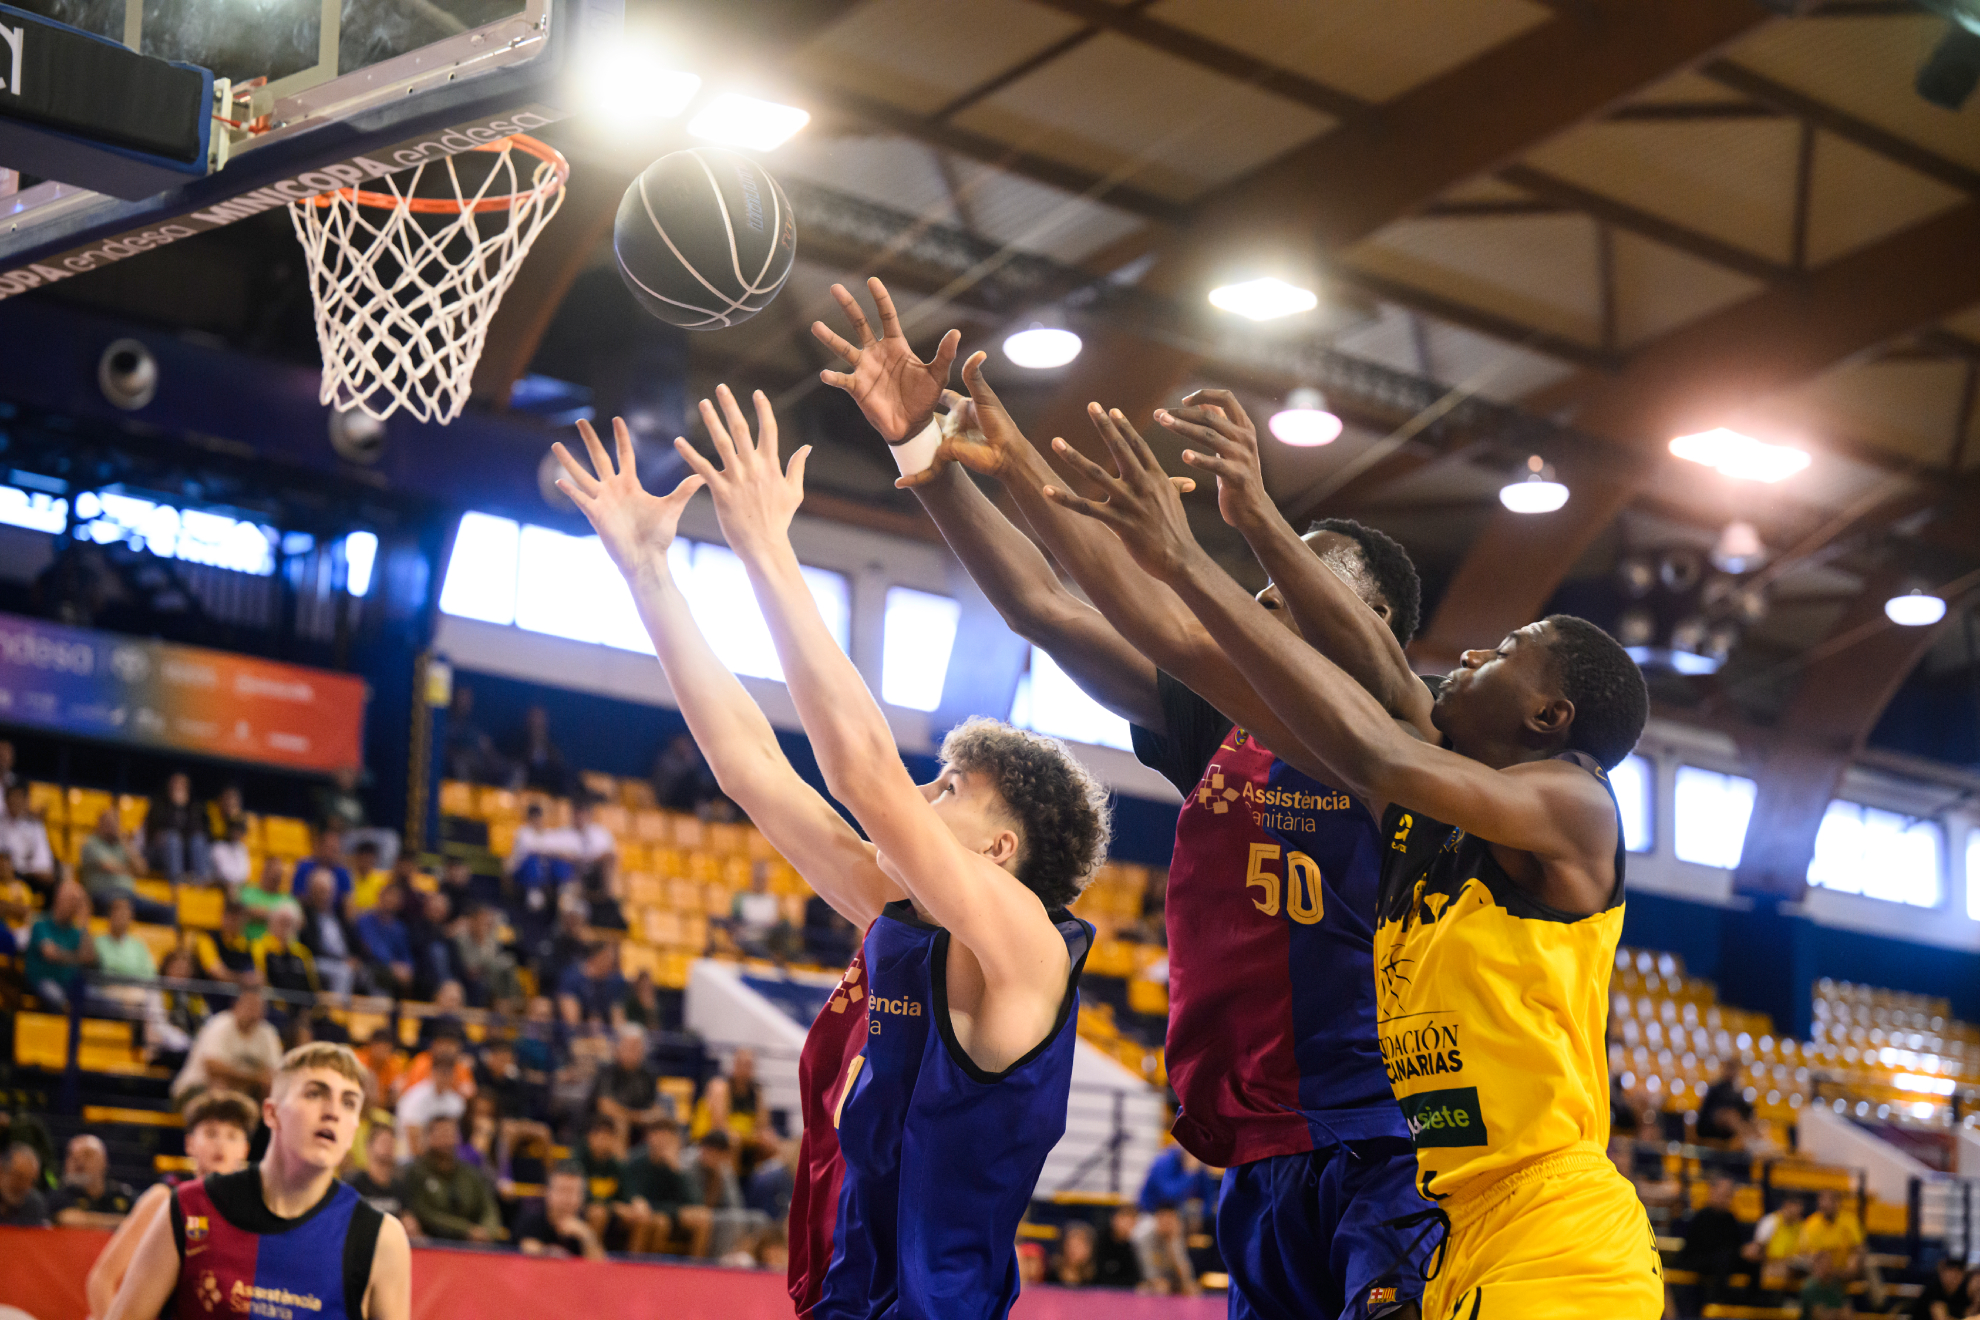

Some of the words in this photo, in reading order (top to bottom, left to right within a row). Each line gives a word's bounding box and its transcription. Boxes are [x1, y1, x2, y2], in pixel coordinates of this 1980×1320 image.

[0, 263, 75, 300] OPA
[63, 224, 198, 272] endesa
[190, 156, 400, 225] MINICOPA
[393, 111, 554, 165] endesa
[1242, 781, 1350, 811] Assistència
[1246, 842, 1324, 925] 50
